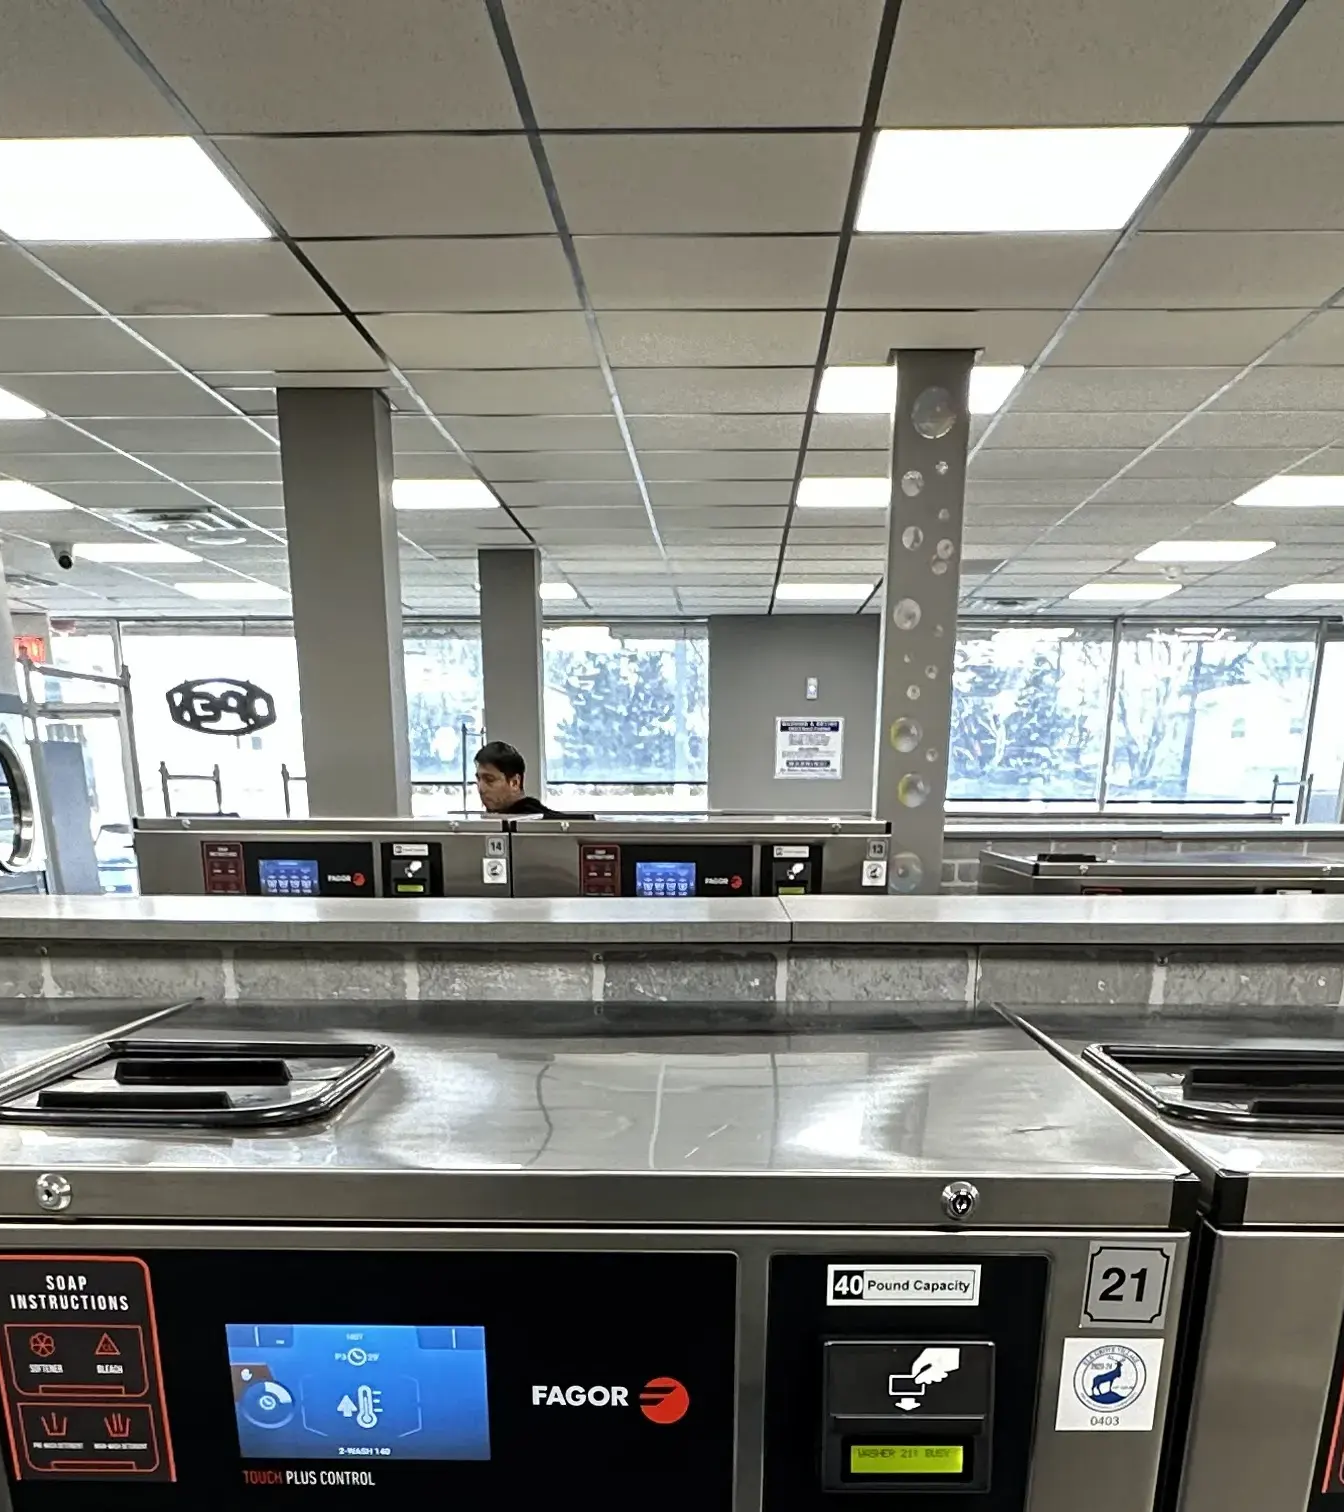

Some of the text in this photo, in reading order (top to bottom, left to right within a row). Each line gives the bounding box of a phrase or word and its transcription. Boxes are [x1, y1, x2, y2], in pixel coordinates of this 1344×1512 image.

[490, 842, 502, 851] 14
[871, 844, 883, 854] 13
[45, 1275, 87, 1291] SOAP
[834, 1275, 971, 1295] 40 Pound Capacity
[1099, 1267, 1148, 1302] 21
[10, 1294, 129, 1311] INSTRUCTIONS
[532, 1385, 628, 1407] FAGOR
[1090, 1416, 1120, 1426] 0403
[243, 1470, 375, 1486] TOUCH PLUS CONTROL
